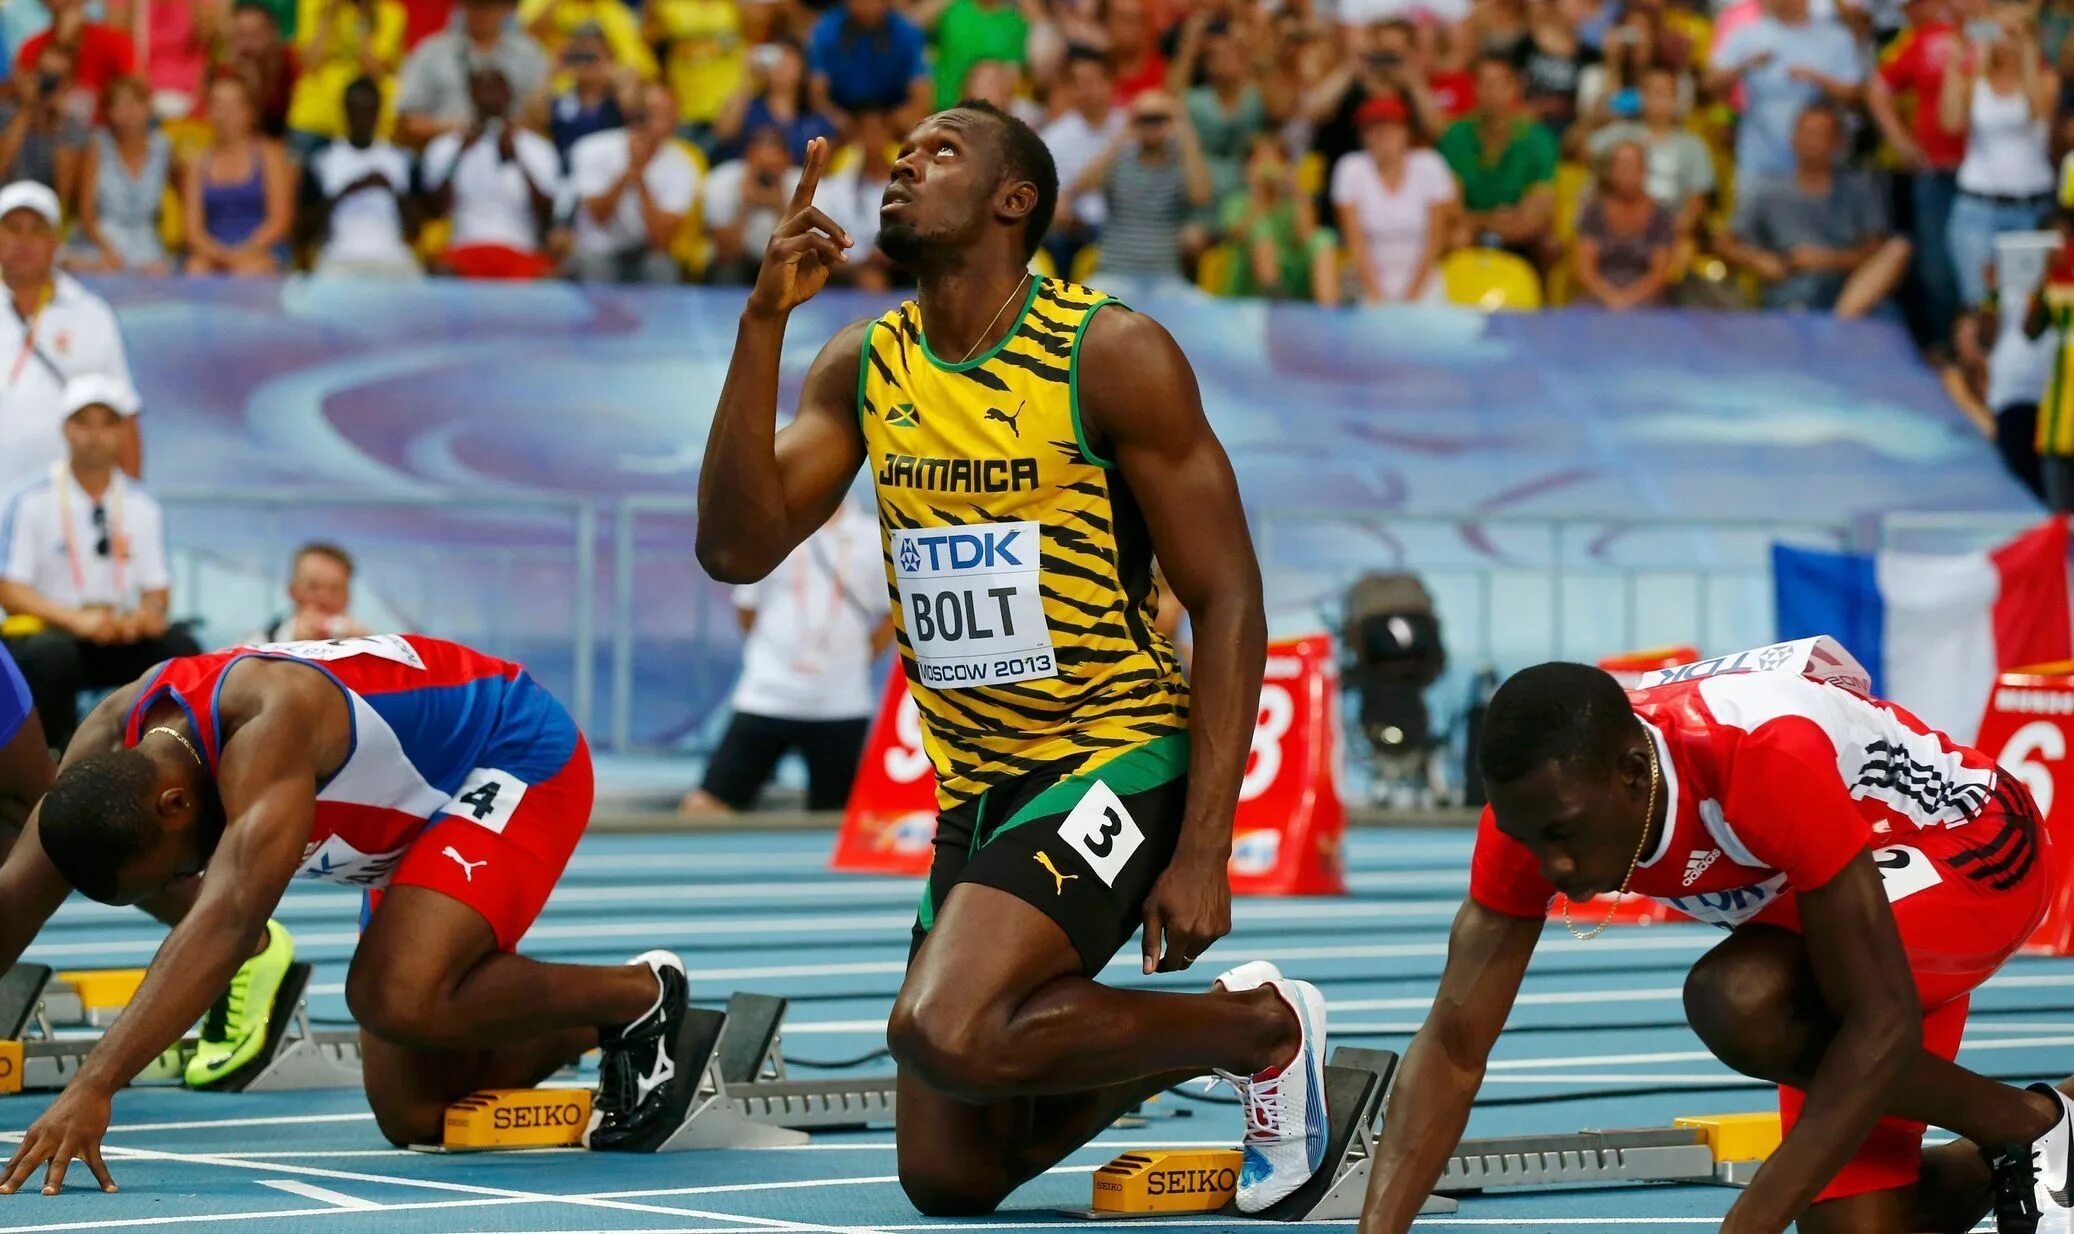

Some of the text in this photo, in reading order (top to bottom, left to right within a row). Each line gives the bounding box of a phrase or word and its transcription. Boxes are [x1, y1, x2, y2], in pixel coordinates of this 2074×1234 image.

[879, 453, 1039, 493] JAMAICA
[917, 531, 1023, 571] TDK
[911, 586, 1017, 642] BOLT
[919, 654, 1051, 682] MOSCOW 2013
[1996, 720, 2067, 823] 6
[460, 781, 502, 820] 4
[1083, 805, 1123, 859] 3
[1682, 848, 1721, 887] adidas
[494, 1103, 581, 1129] SEIKO
[1096, 1181, 1123, 1192] SEIKO
[1148, 1168, 1237, 1195] SEIKO
